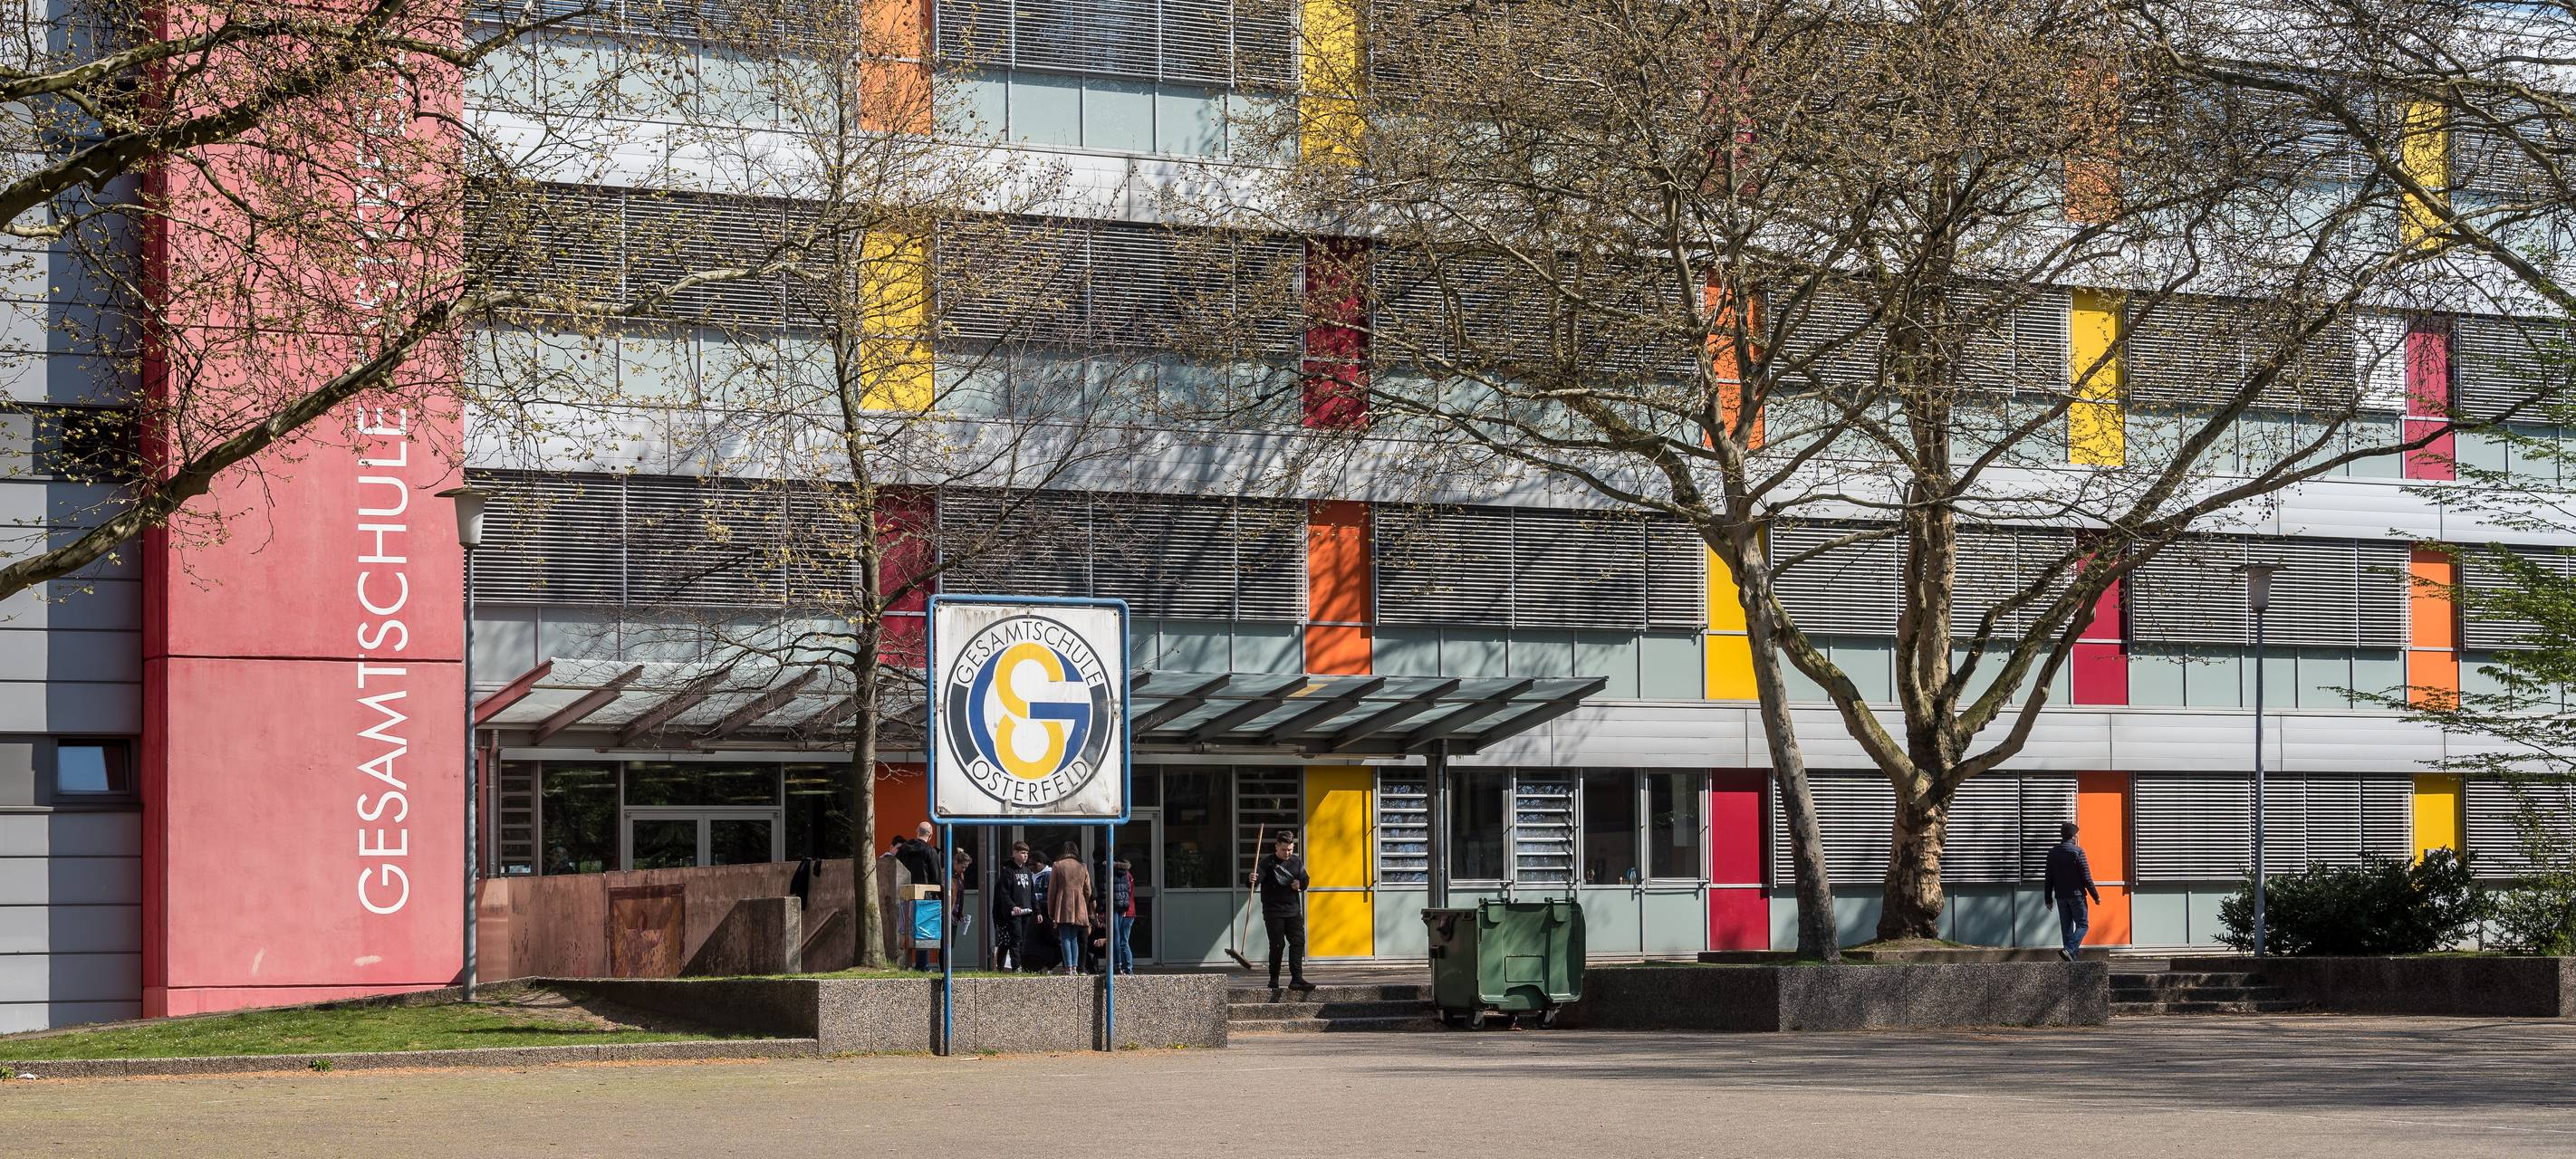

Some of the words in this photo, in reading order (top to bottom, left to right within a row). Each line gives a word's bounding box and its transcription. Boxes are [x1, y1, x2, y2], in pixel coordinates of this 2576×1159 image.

[356, 406, 410, 915] GESAMTSCHULE
[956, 620, 1104, 686] GESAMTSCHULE
[972, 759, 1088, 802] OSTERFELD
